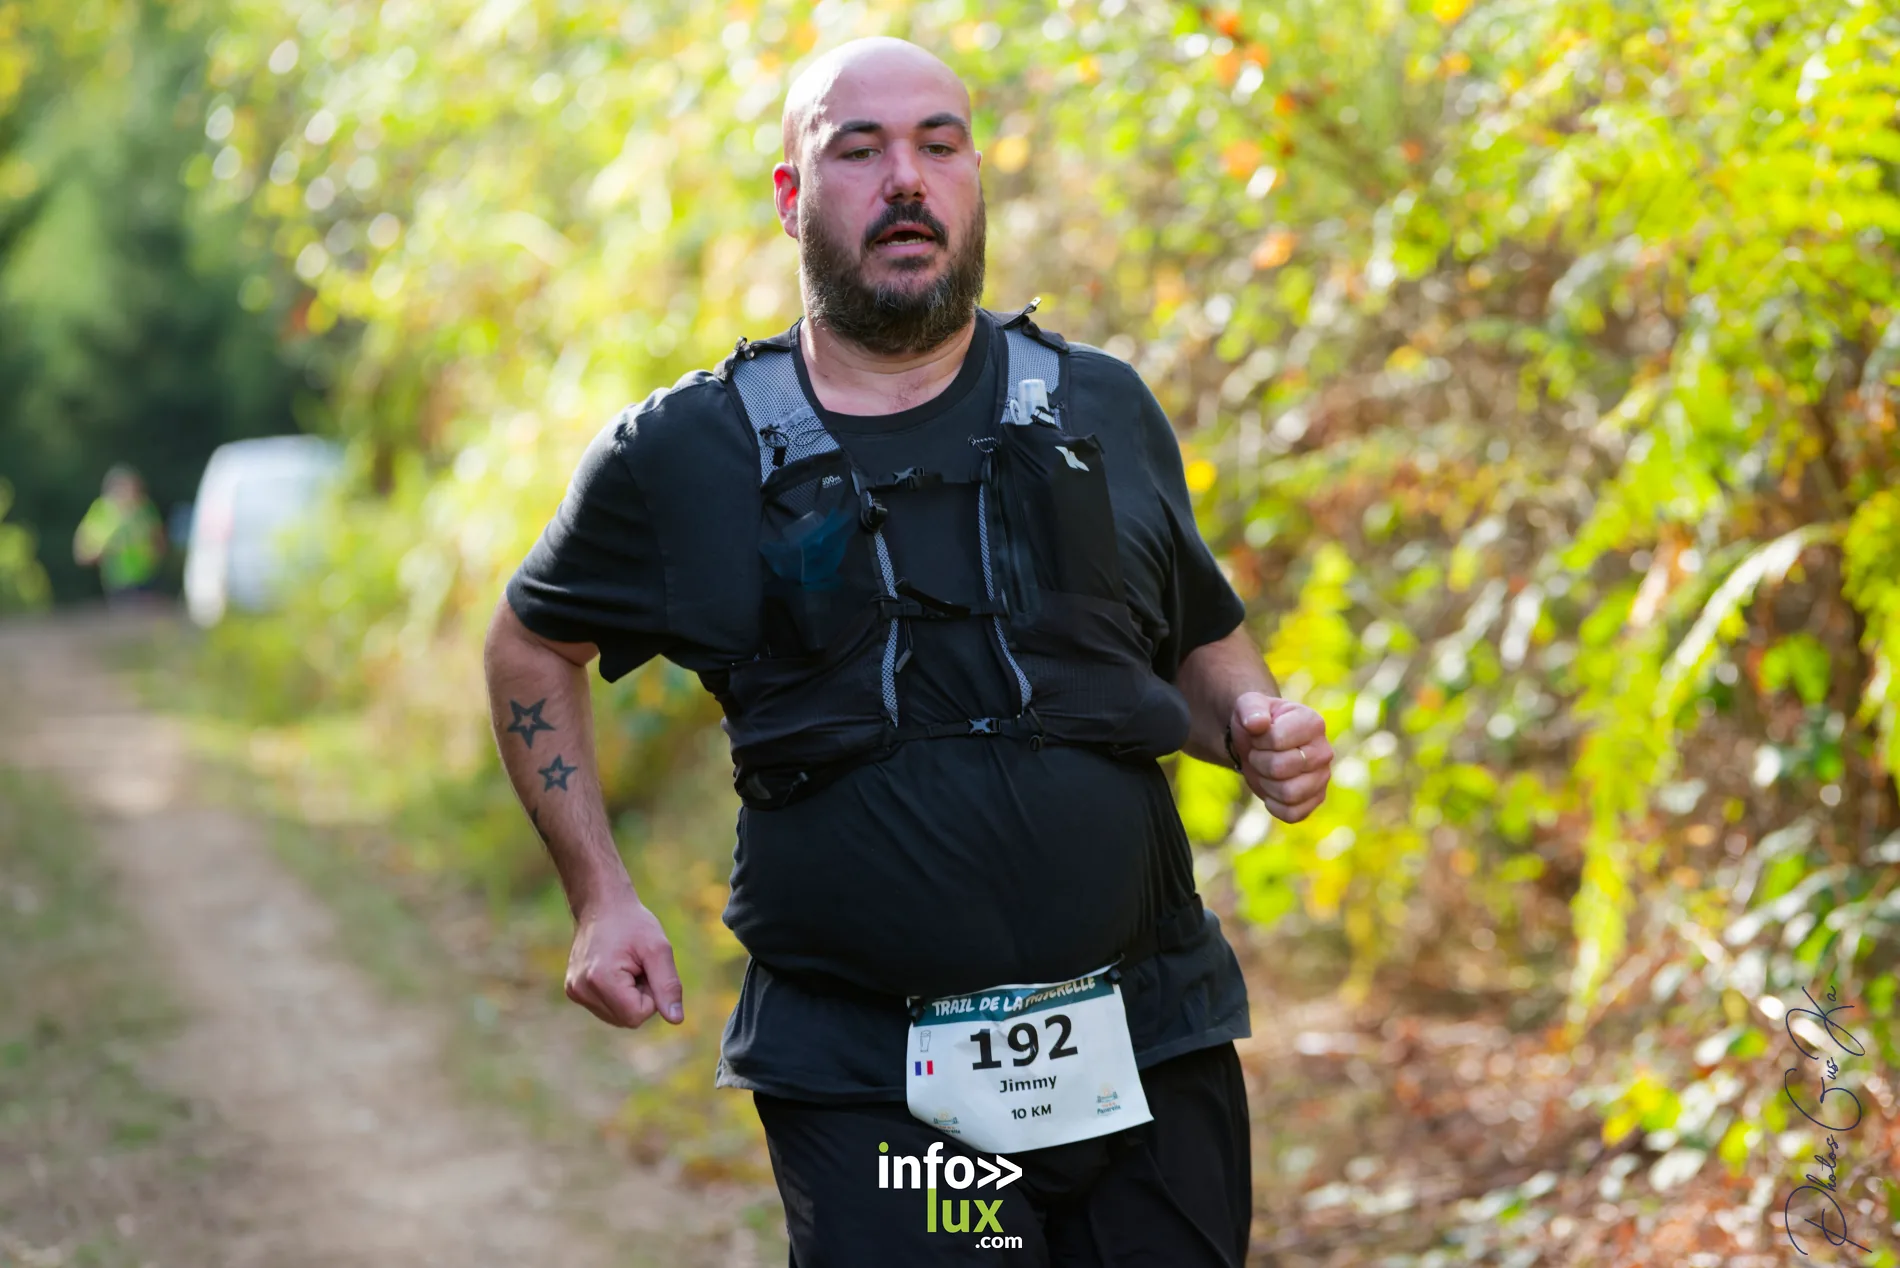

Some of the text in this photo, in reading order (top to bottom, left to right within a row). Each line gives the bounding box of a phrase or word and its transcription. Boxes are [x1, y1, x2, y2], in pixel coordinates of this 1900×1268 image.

[932, 998, 975, 1016] TRAIL
[979, 996, 1000, 1012] DE
[1003, 996, 1023, 1012] LA
[970, 1014, 1078, 1071] 192
[1000, 1075, 1057, 1094] Jimmy
[1011, 1104, 1052, 1120] 10 KM
